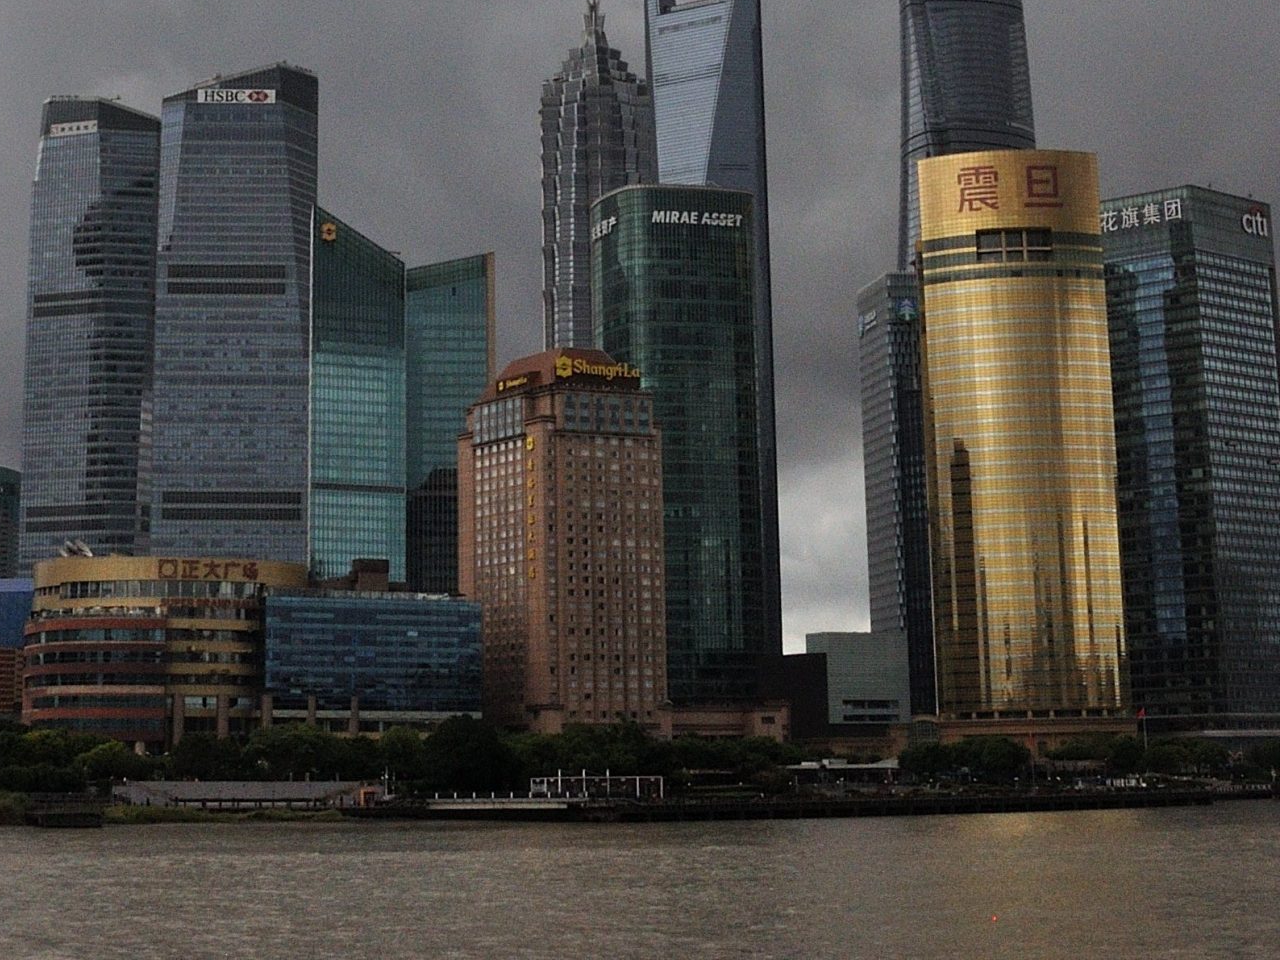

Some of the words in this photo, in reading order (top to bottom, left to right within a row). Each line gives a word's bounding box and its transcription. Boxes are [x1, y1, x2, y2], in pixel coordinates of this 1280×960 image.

[204, 90, 246, 102] HSBC
[957, 166, 1064, 212] 震旦
[651, 210, 699, 225] MIRAE
[702, 212, 743, 227] ASSET
[1100, 198, 1182, 233] 花旗集团
[1242, 211, 1268, 237] citi
[573, 359, 640, 381] Shangri-La
[181, 560, 259, 580] 正大广场
